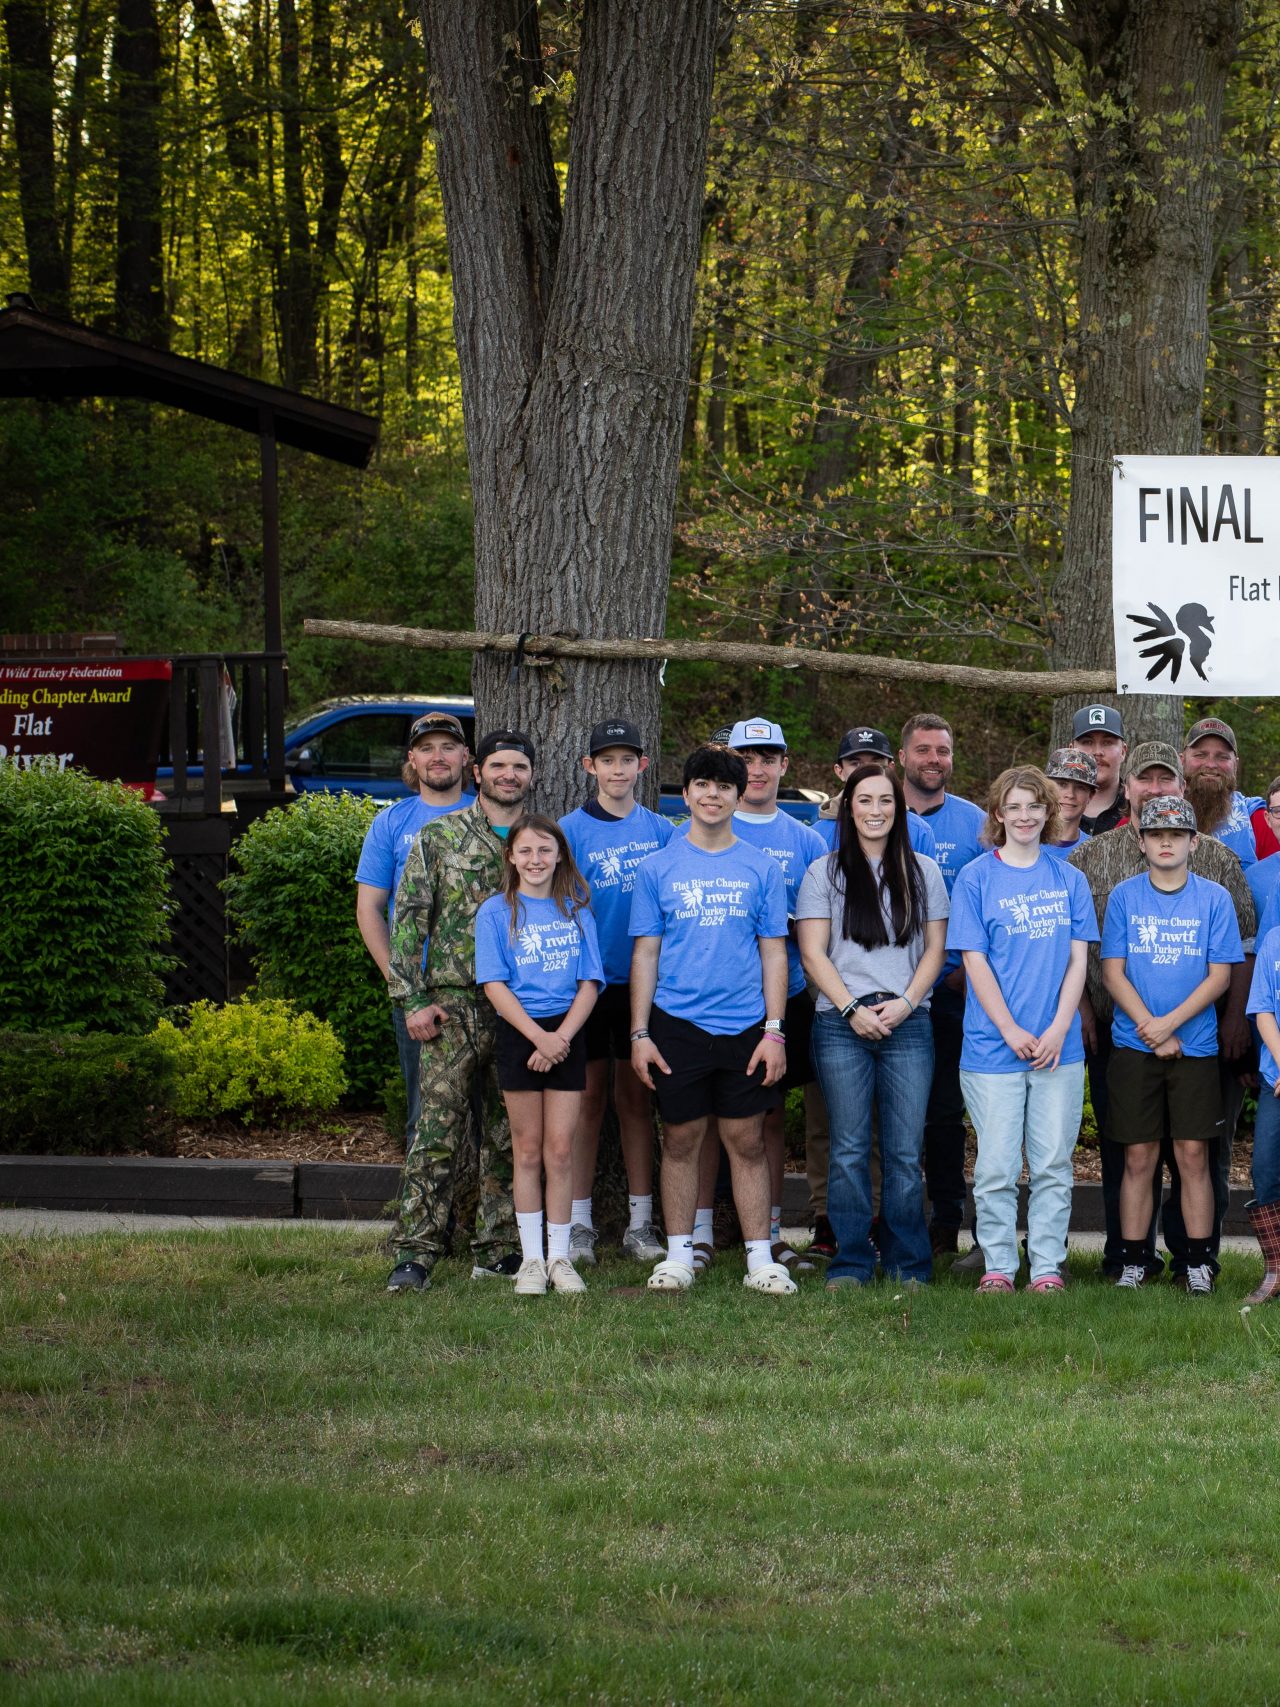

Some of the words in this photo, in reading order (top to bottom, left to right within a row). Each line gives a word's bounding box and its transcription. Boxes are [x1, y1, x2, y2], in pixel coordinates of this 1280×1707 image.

[1139, 484, 1263, 545] FINAL
[1229, 575, 1270, 601] Flat
[6, 668, 31, 678] Wild
[32, 668, 66, 680] Turkey
[68, 667, 122, 678] Federation
[32, 689, 87, 708] Chapter
[89, 687, 131, 703] Award
[12, 713, 53, 736] Flat
[404, 834, 415, 844] Fl
[607, 846, 628, 857] River
[630, 841, 659, 853] Chapter
[936, 841, 956, 851] apter
[594, 878, 618, 889] Youth
[673, 881, 689, 892] Flat
[692, 879, 714, 888] River
[716, 878, 750, 890] Chapter
[1019, 894, 1038, 904] River
[675, 910, 699, 920] Youth
[700, 906, 727, 917] Turkey
[700, 915, 725, 926] 2024
[1149, 915, 1170, 925] River
[528, 923, 550, 933] River
[1006, 925, 1028, 936] Youth
[1029, 919, 1056, 930] Turkey
[1030, 927, 1055, 940] 2024
[1129, 943, 1151, 953] Youth
[1154, 943, 1181, 956] Turkey
[1184, 945, 1202, 957] Hunt
[515, 955, 540, 966] Youth
[543, 958, 568, 972] 2024
[1152, 954, 1180, 964] 2024
